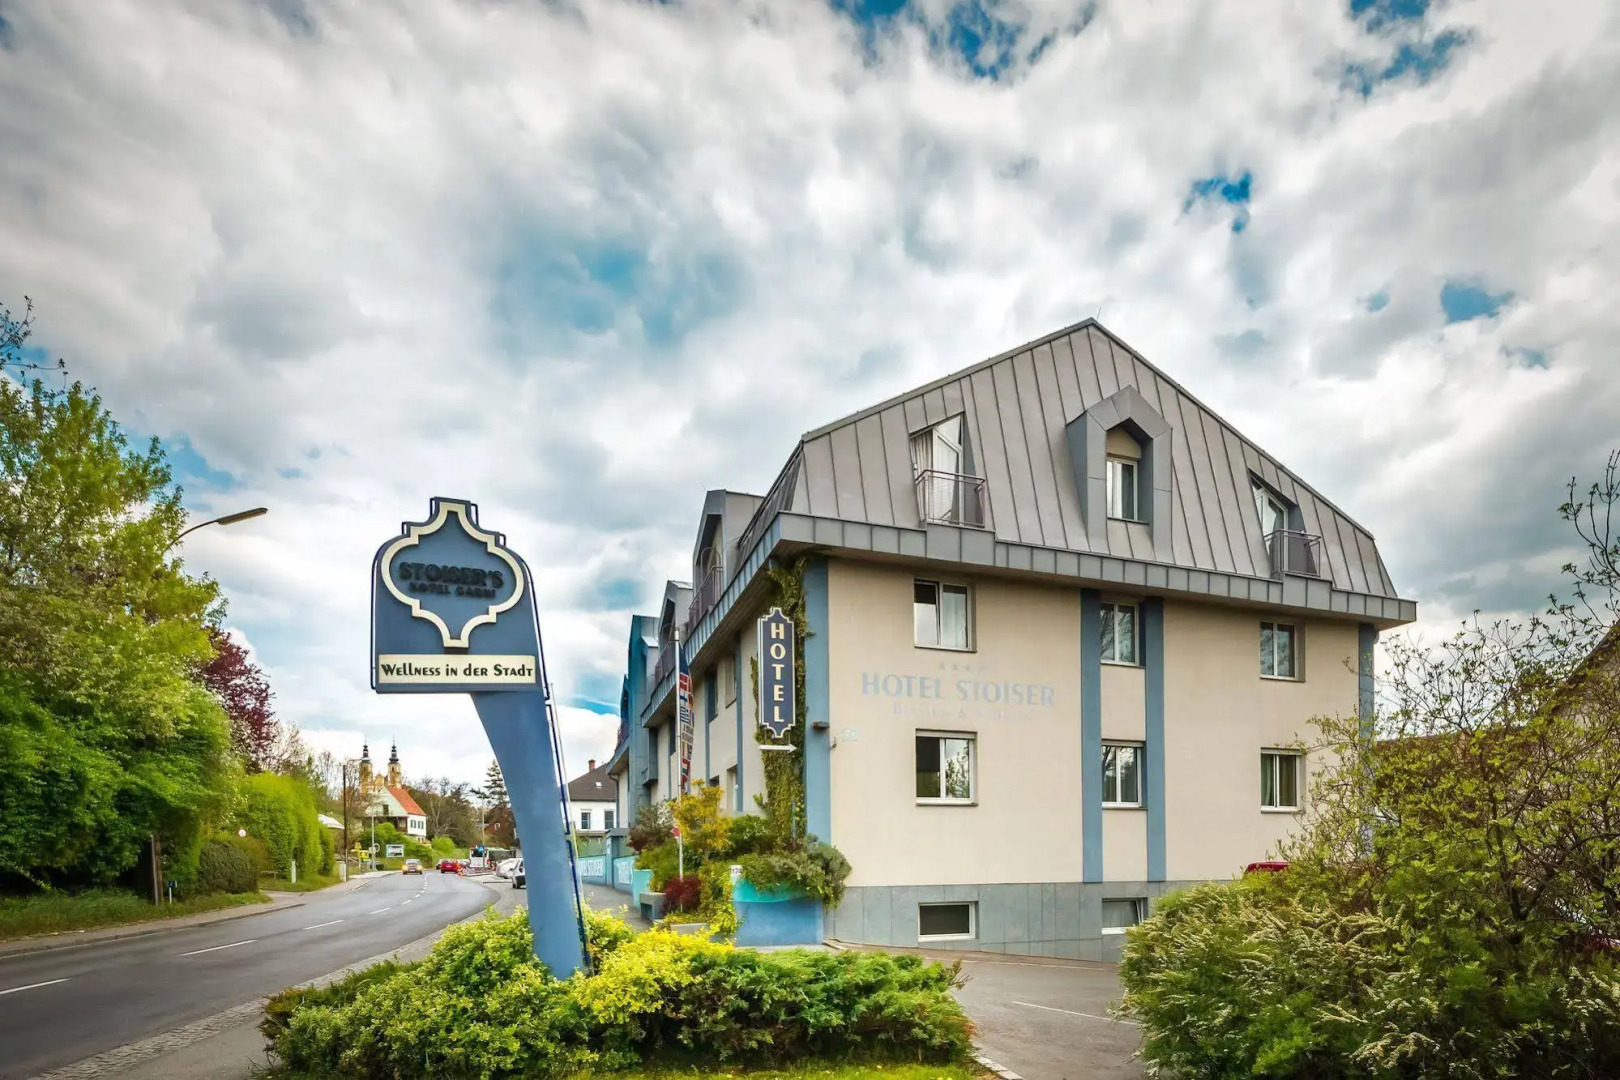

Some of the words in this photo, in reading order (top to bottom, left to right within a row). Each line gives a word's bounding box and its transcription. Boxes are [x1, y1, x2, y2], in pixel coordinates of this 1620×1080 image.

[399, 561, 504, 589] STOISER'S
[409, 581, 451, 595] HOTEL
[769, 622, 787, 723] HOTEL
[861, 671, 944, 700] HOTEL
[955, 678, 1055, 707] STOISER
